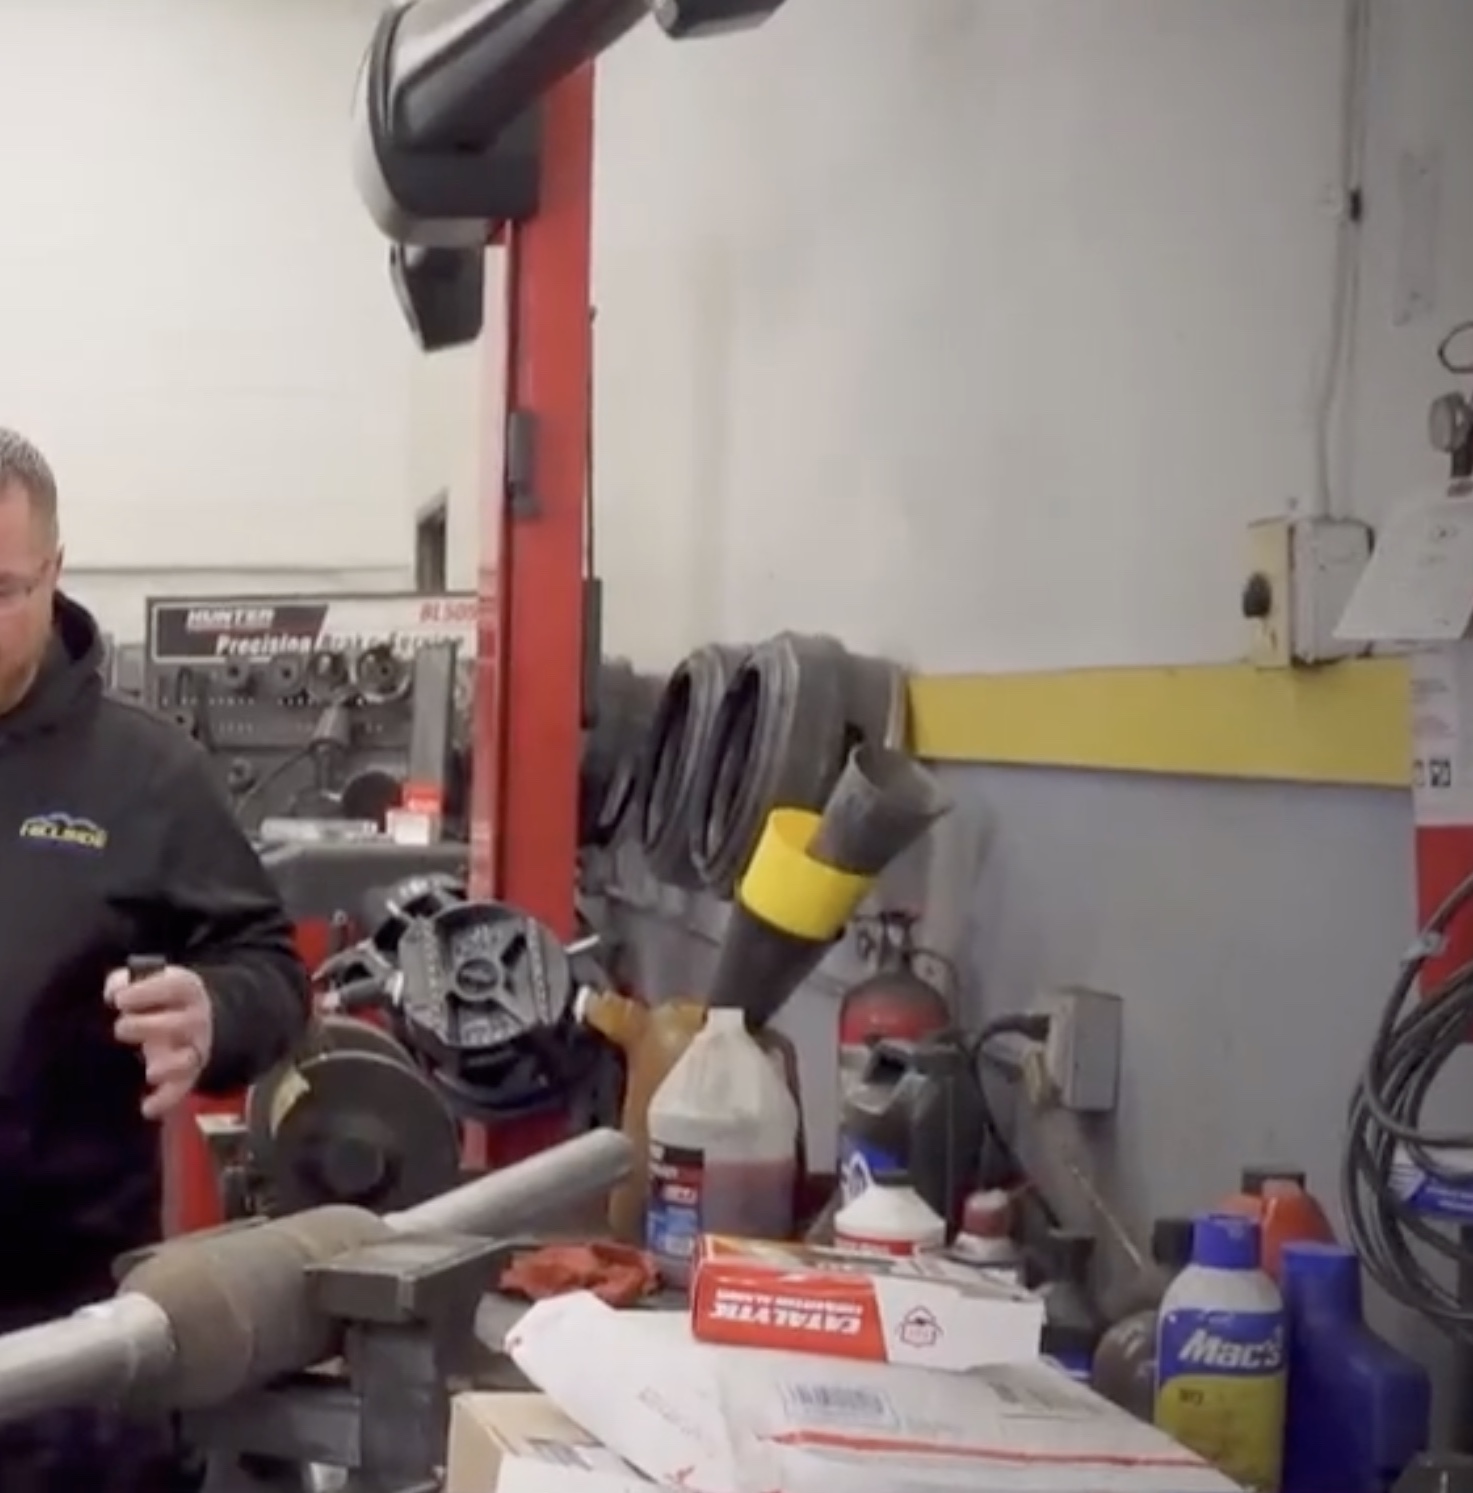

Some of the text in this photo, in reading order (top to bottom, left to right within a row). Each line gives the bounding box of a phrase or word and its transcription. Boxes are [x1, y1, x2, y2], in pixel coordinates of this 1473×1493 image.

[186, 608, 275, 631] HUNTER
[215, 633, 312, 655] Precision
[1178, 1328, 1282, 1370] Mac's
